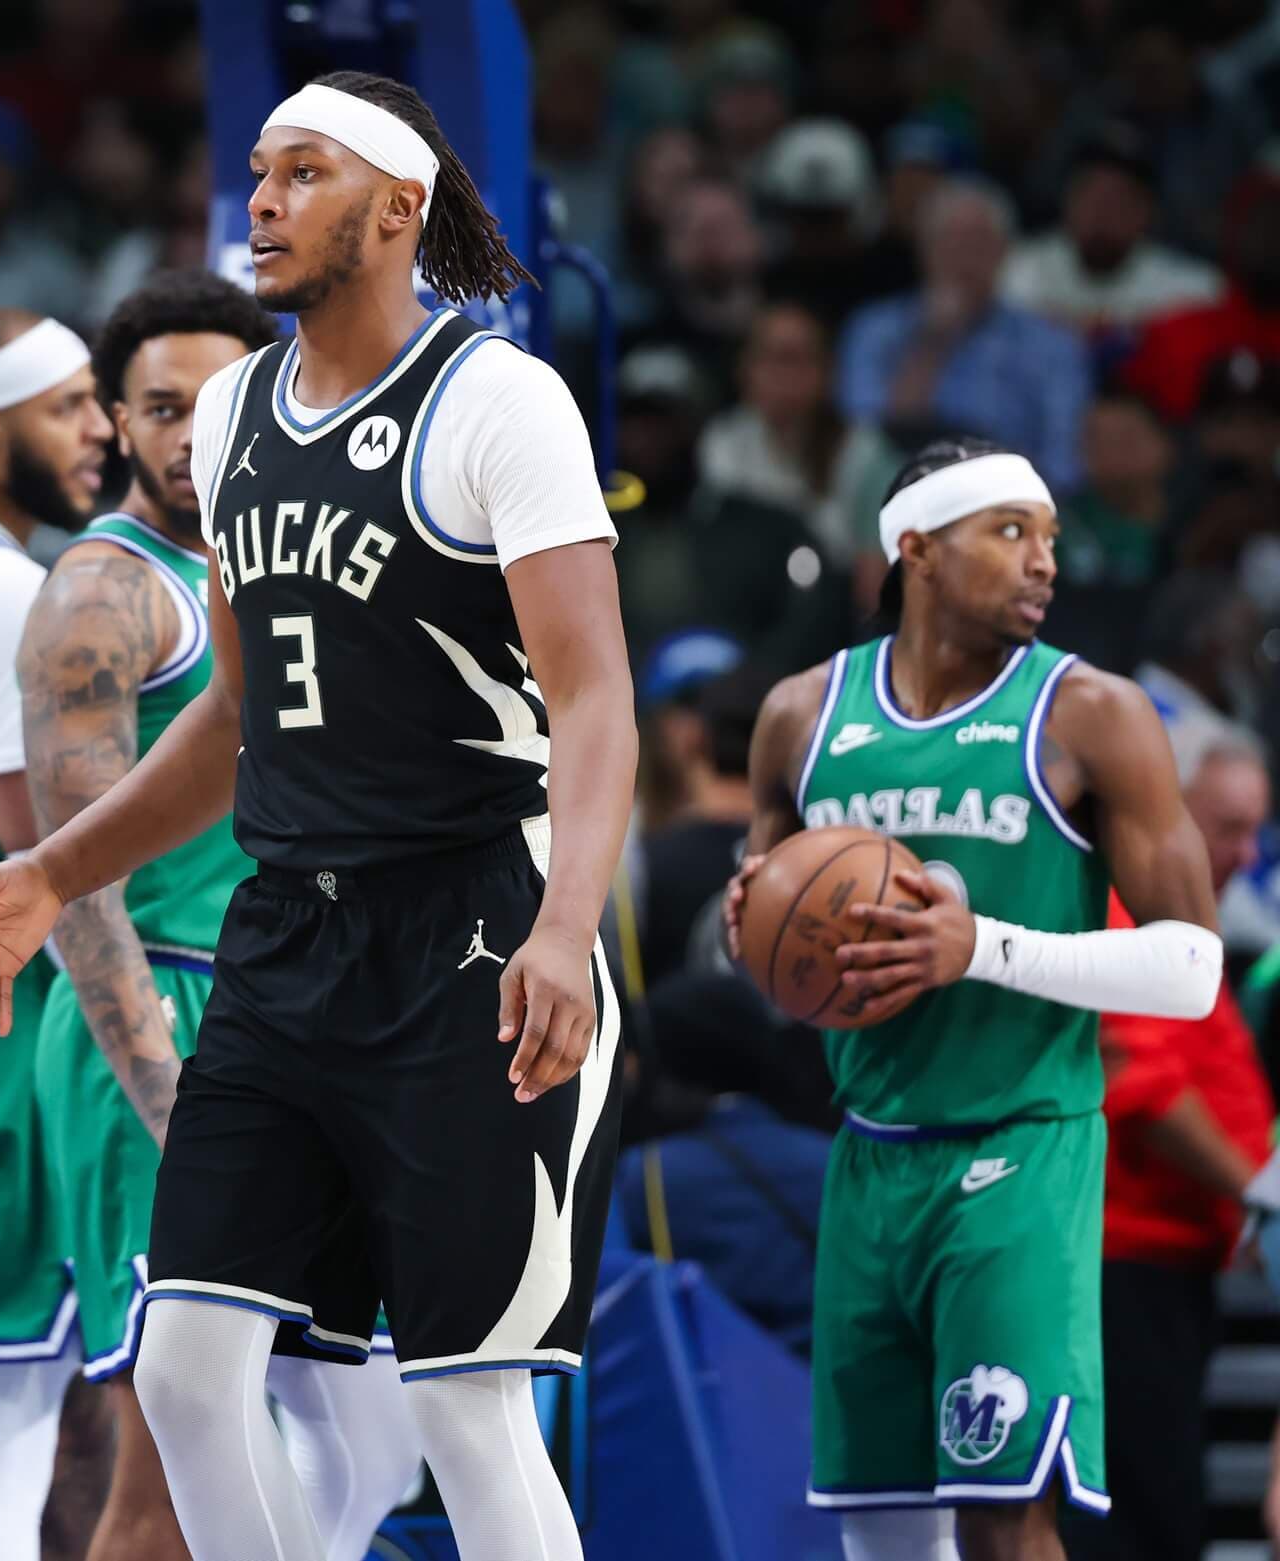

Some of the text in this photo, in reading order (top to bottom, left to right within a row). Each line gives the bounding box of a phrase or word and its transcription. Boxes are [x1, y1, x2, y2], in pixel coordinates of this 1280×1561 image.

[215, 500, 400, 606] BUCKS
[269, 612, 326, 730] 3
[955, 721, 1019, 744] chime
[805, 787, 1031, 844] DALLAS
